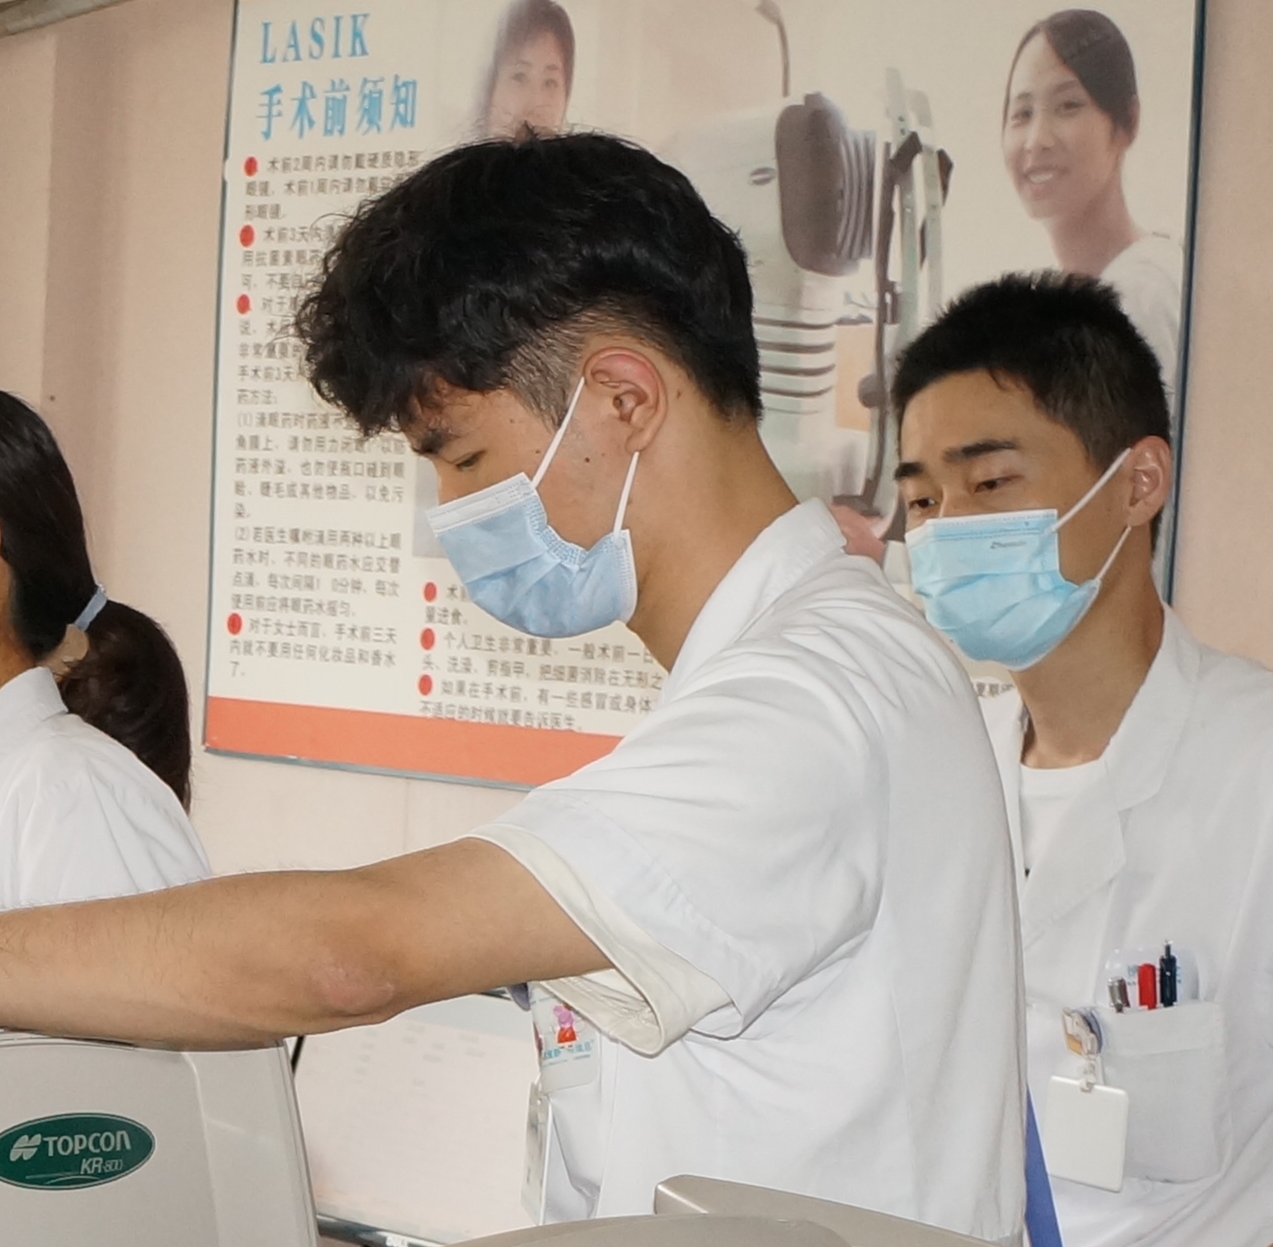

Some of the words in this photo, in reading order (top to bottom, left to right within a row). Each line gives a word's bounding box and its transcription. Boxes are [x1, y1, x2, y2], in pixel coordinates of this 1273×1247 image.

[260, 13, 370, 64] LASIK
[256, 74, 417, 141] 手术前须知
[43, 1130, 132, 1157] TOPCON
